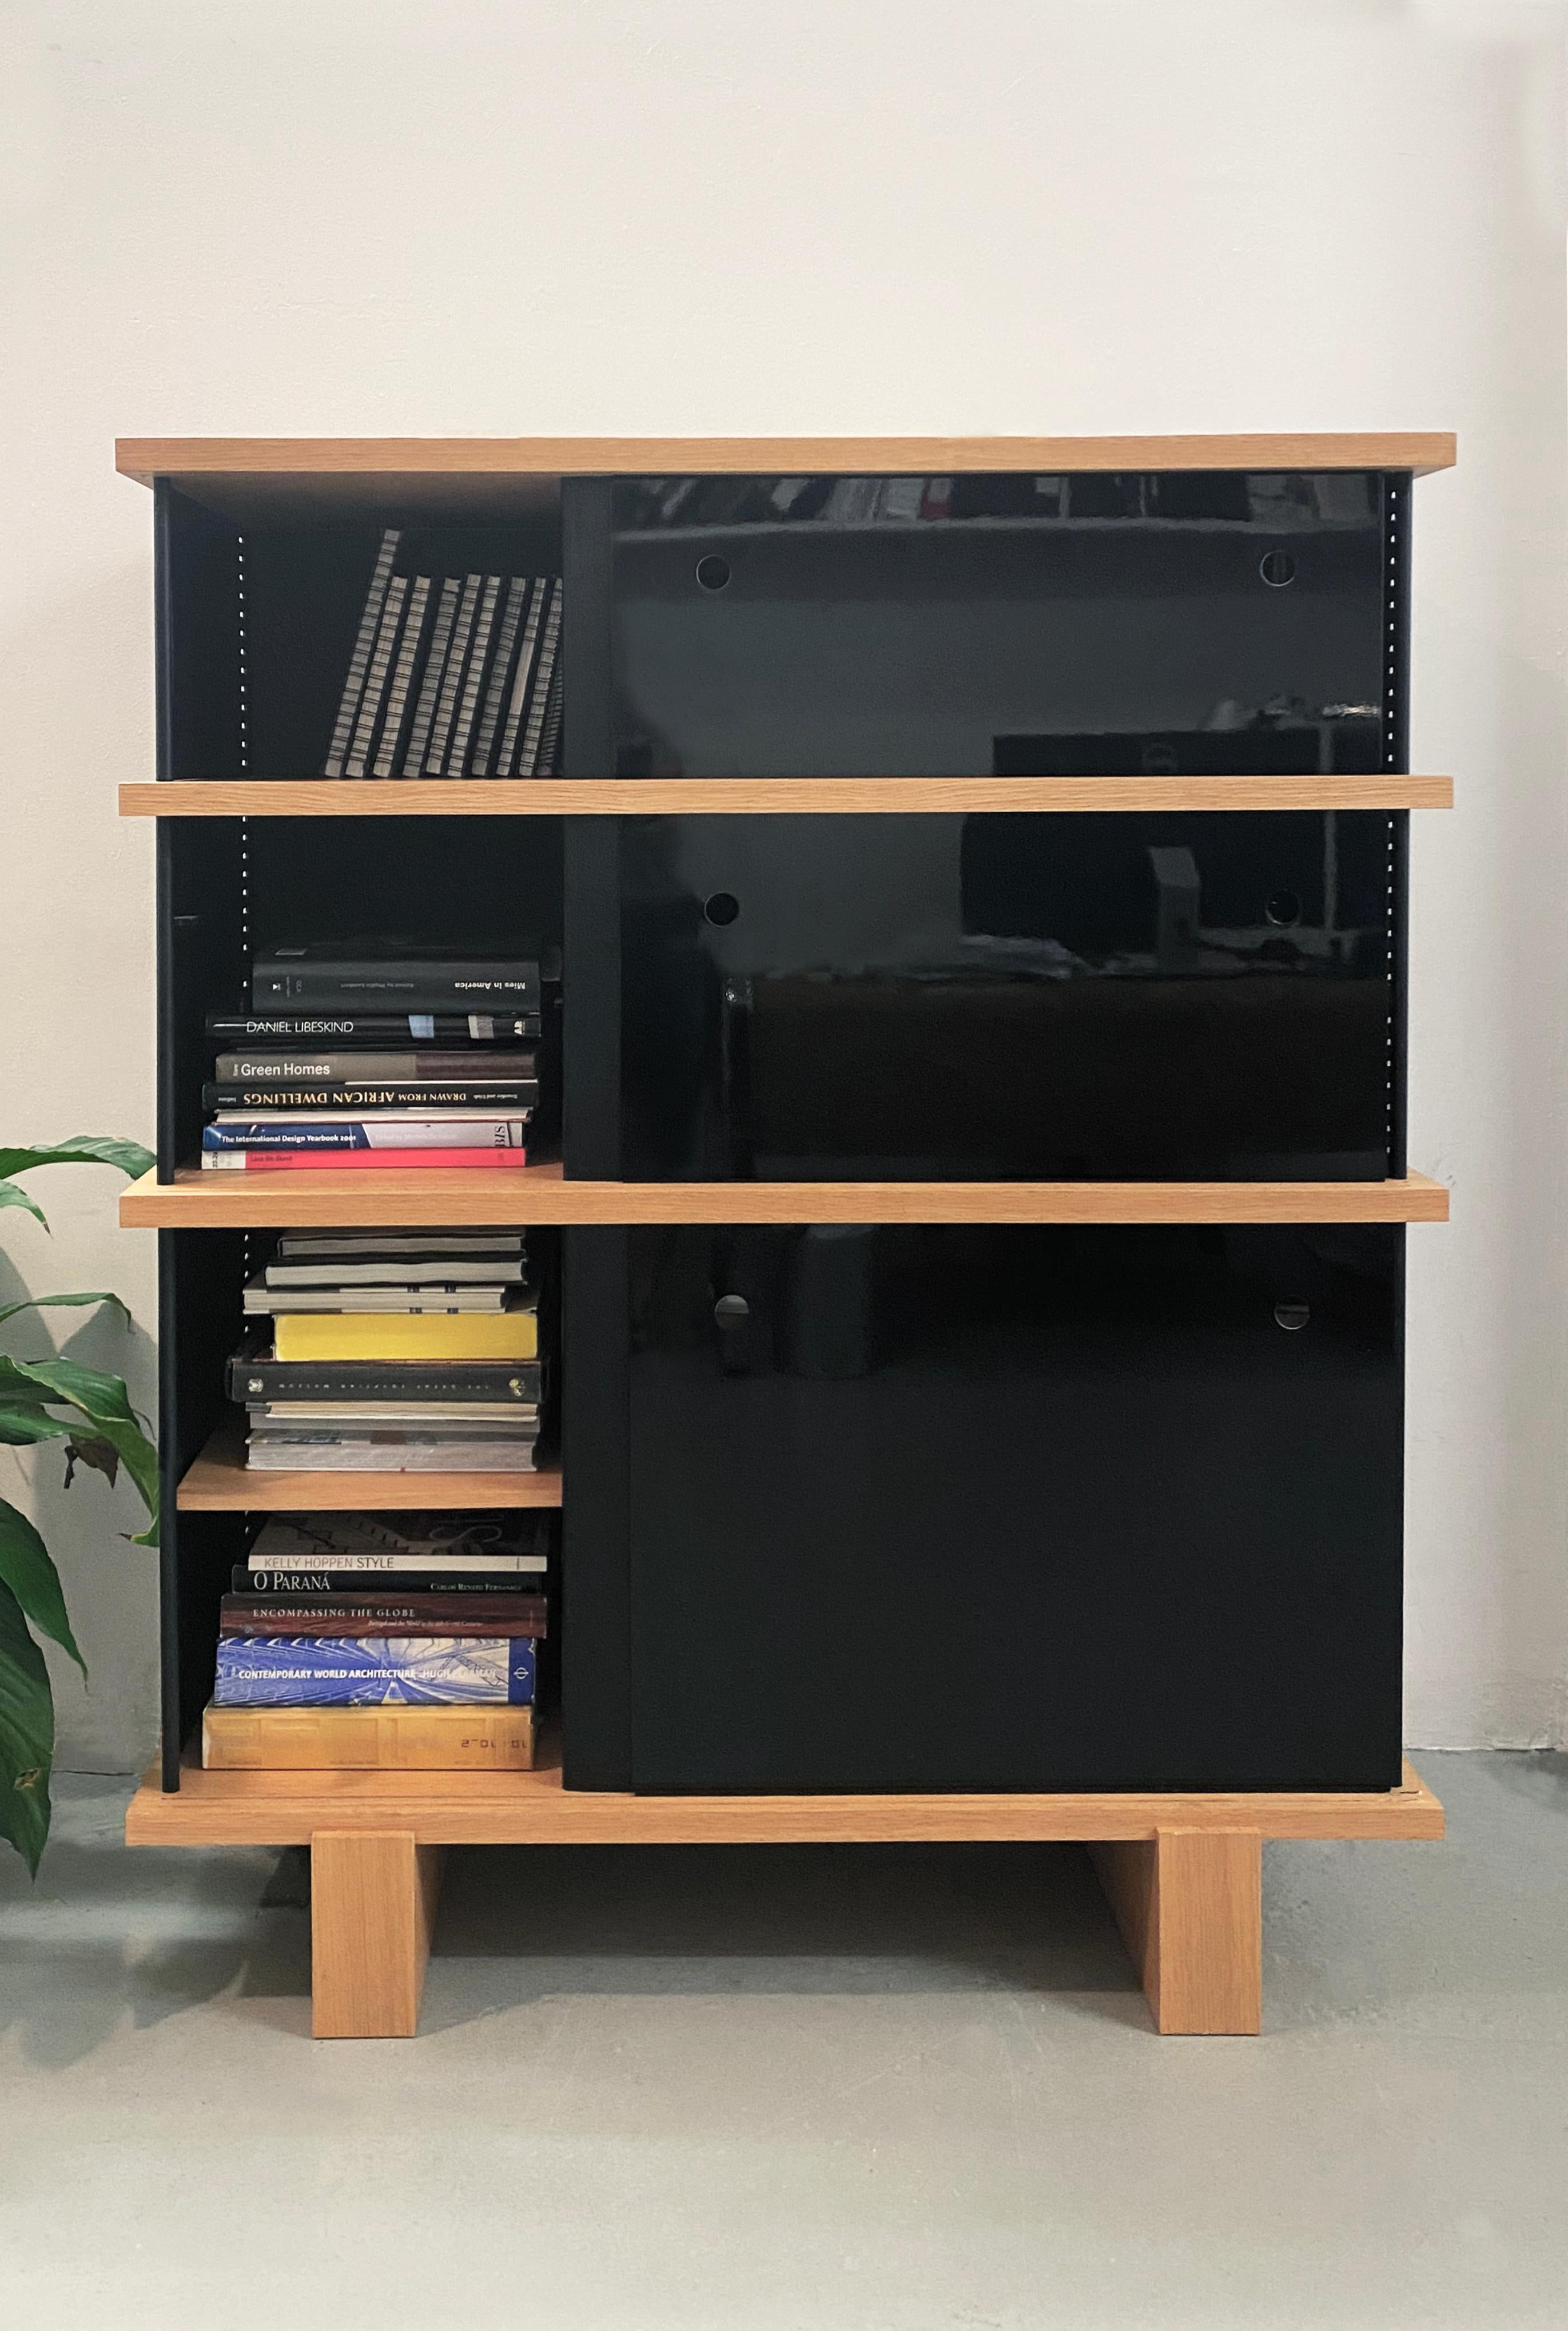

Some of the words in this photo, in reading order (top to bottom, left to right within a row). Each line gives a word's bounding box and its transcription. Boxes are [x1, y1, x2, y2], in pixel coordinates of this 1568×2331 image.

[246, 1021, 292, 1033] DANIEL
[295, 1021, 353, 1033] LIBESKIND
[241, 1063, 280, 1075] Green
[284, 1062, 330, 1075] Homes
[244, 1093, 327, 1105] DWELLINGS
[333, 1091, 395, 1103] AFRICAN
[398, 1093, 427, 1101] FROM
[429, 1093, 467, 1101] DRAWN
[236, 1134, 281, 1142] International
[282, 1134, 305, 1143] Design
[307, 1134, 339, 1142] Yearbook
[264, 1557, 301, 1568] KELLY
[304, 1557, 353, 1568] HOPPEN
[357, 1556, 395, 1568] STYLE
[254, 1571, 268, 1590] O
[253, 1609, 345, 1618] ENCOMPASSING
[350, 1609, 372, 1617] THE
[376, 1608, 416, 1617] GLOBE
[238, 1670, 312, 1679] CONTEMPORARY
[314, 1669, 347, 1679] WORLD
[348, 1669, 416, 1679] ARCHITECTURE
